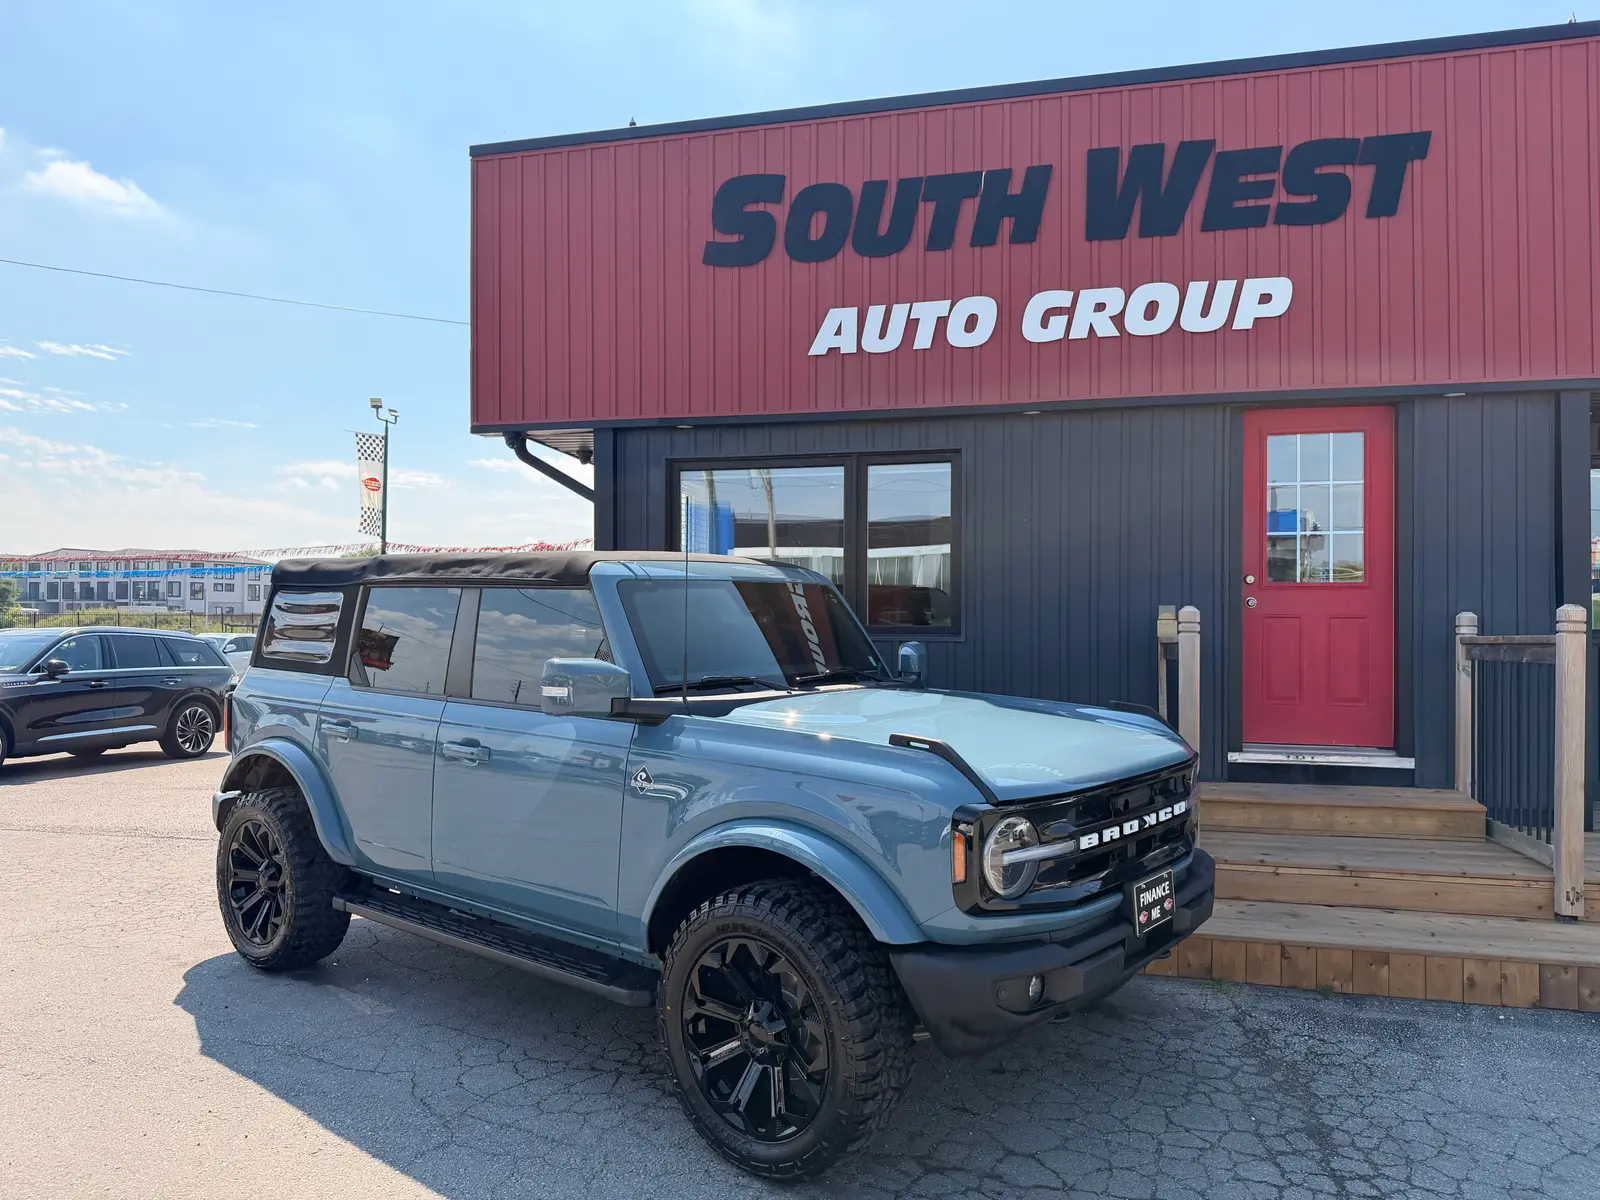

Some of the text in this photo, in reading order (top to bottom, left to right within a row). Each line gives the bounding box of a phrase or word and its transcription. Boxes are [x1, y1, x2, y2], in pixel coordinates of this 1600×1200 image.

[703, 130, 1432, 267] SOUTH WEST
[808, 276, 1293, 356] AUTO GROUP
[1079, 800, 1186, 850] BRONCO
[1139, 881, 1170, 908] FINANCE
[1151, 905, 1161, 921] ME
